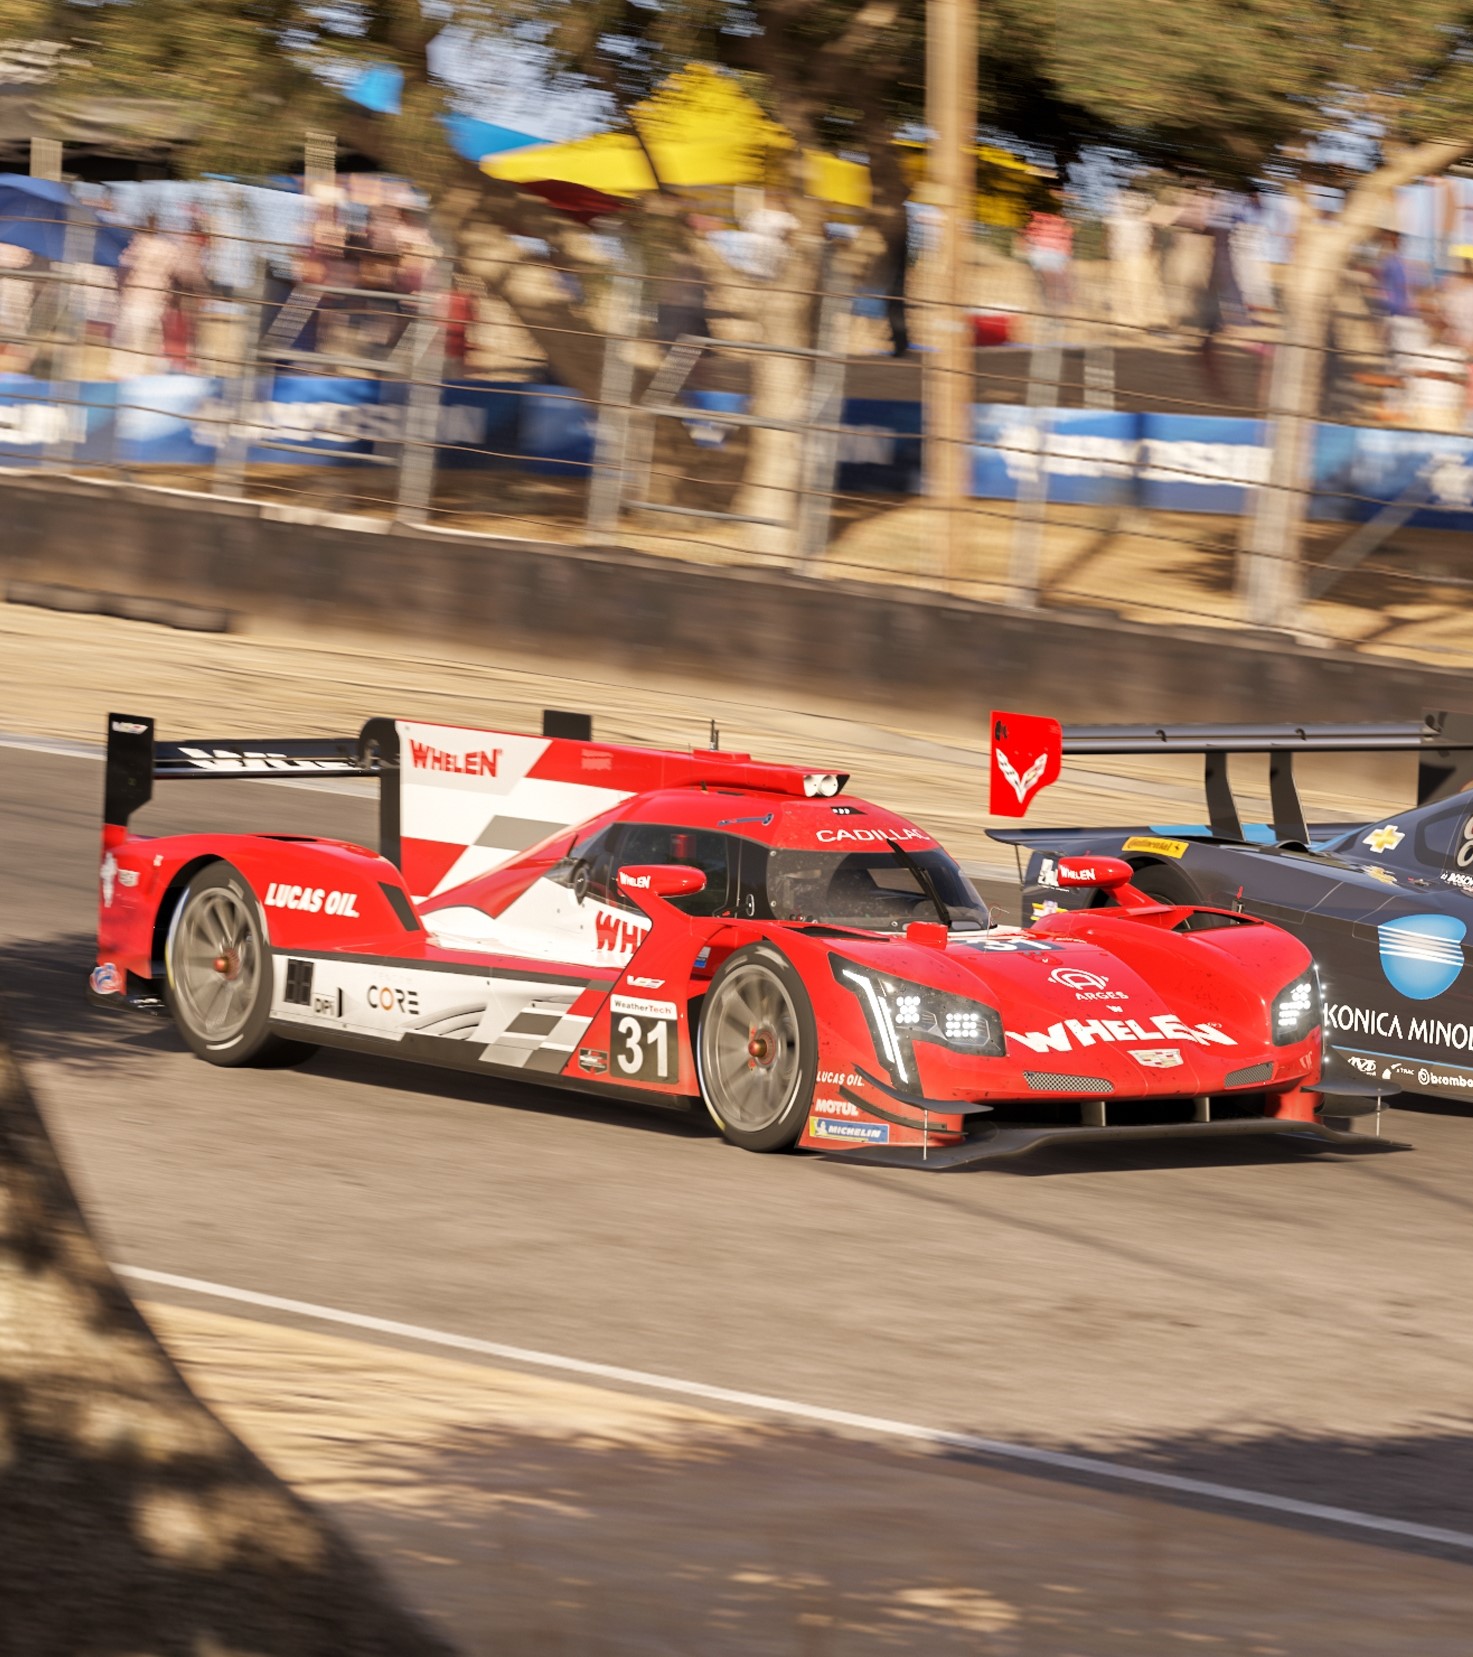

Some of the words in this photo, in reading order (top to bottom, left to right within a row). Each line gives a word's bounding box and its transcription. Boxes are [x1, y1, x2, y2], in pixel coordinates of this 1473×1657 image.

[408, 738, 498, 778] WHELEN
[815, 828, 930, 843] CADILLAC
[619, 871, 651, 889] WHELEN
[1059, 864, 1096, 881] WHELEN
[264, 883, 324, 913] LUCAS
[367, 984, 419, 1015] CORE
[1075, 991, 1129, 1001] ARGES
[615, 1000, 672, 1015] WeatherTech
[1324, 1003, 1403, 1040] KONICA
[1004, 1014, 1238, 1053] WHELEN
[617, 1016, 668, 1077] 31
[816, 1070, 845, 1085] LUCAS
[815, 1098, 859, 1116] MOTUL
[827, 1125, 881, 1138] MICHELIN
